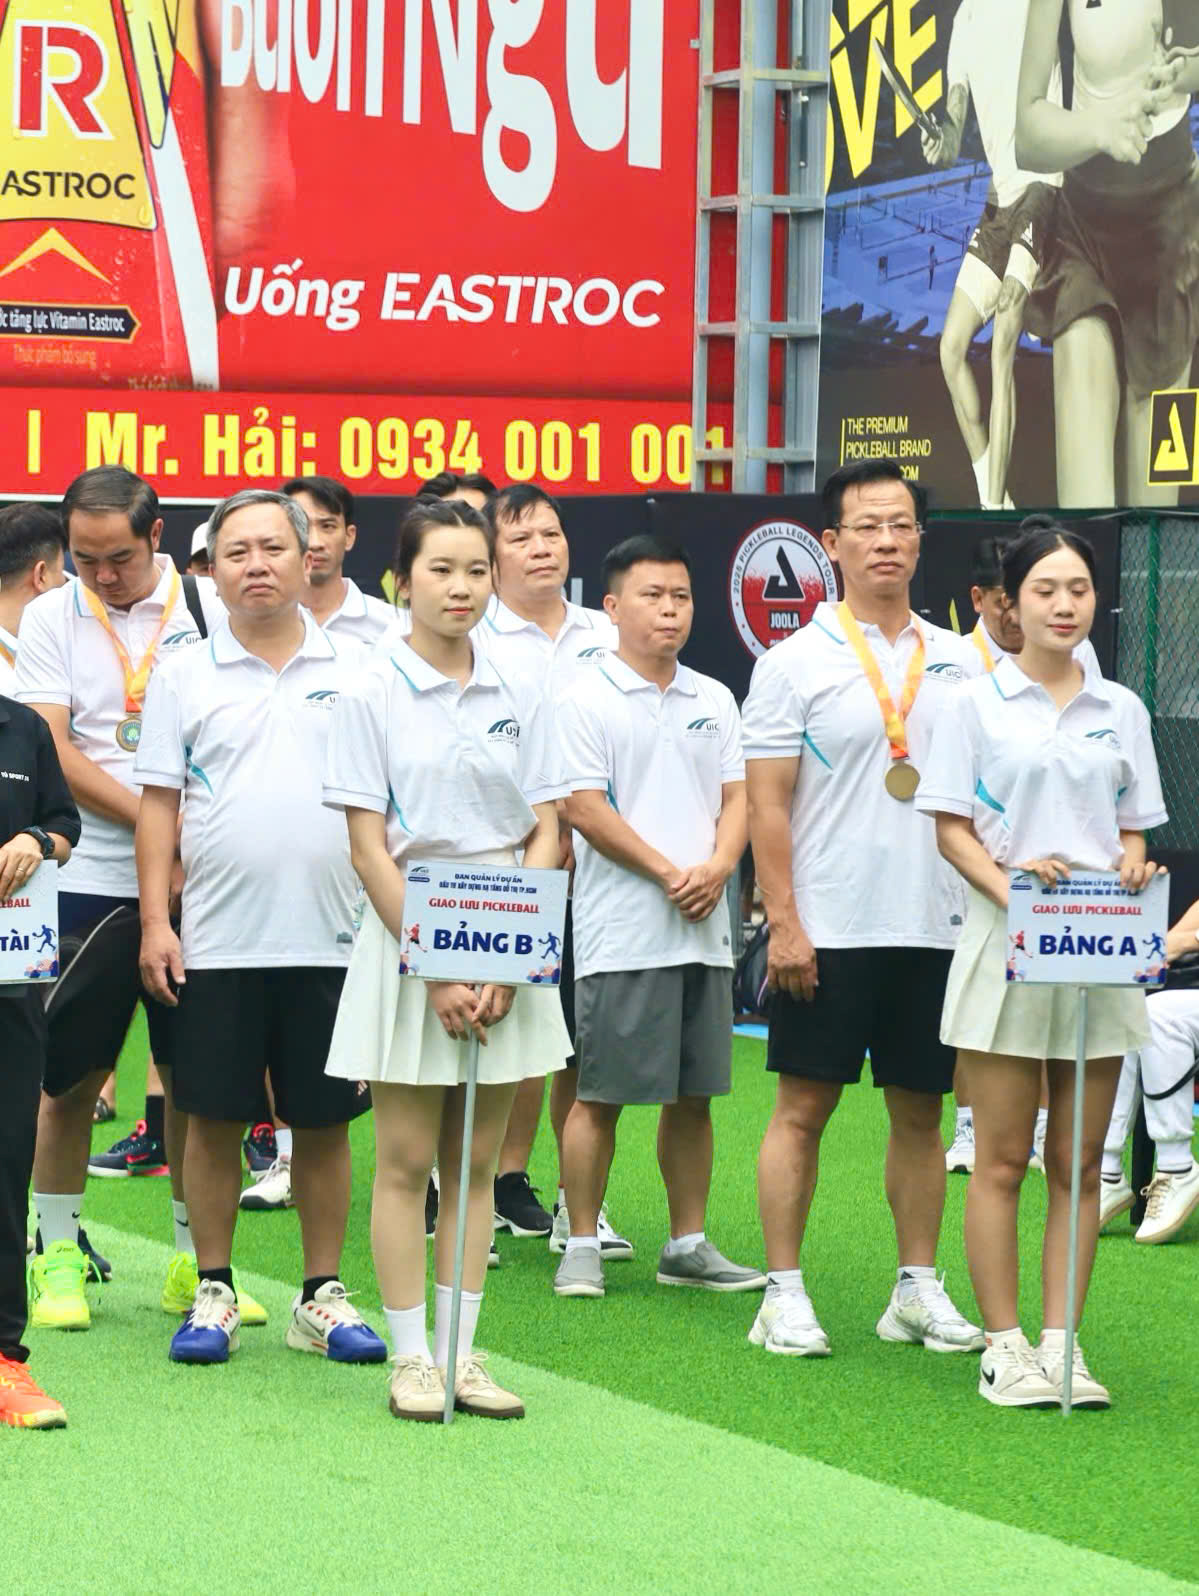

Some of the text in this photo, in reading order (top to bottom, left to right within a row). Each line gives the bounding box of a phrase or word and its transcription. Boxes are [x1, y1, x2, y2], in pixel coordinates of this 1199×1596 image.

[13, 19, 115, 140] R
[224, 258, 666, 331] Uống EASTROC
[49, 311, 87, 330] Vitamin
[89, 312, 126, 332] Eastroc
[847, 415, 908, 436] THE PREMIUM
[86, 411, 180, 475] Mr.
[203, 406, 317, 477] Hải:
[339, 416, 482, 479] 0934
[504, 420, 601, 482] 001
[846, 439, 932, 459] PICKLEBALL BRAND
[739, 526, 784, 564] PICKLEBALL
[786, 527, 824, 560] LEGENDS
[822, 558, 836, 595] TOUR
[770, 612, 800, 629] JOOLA
[429, 897, 540, 914] GIAO LƯU PICKLEBALL
[1032, 904, 1143, 916] GIAO LƯU PICKLEBALL
[433, 920, 533, 955] BẢNG B
[1039, 926, 1137, 956] BẢNG A
